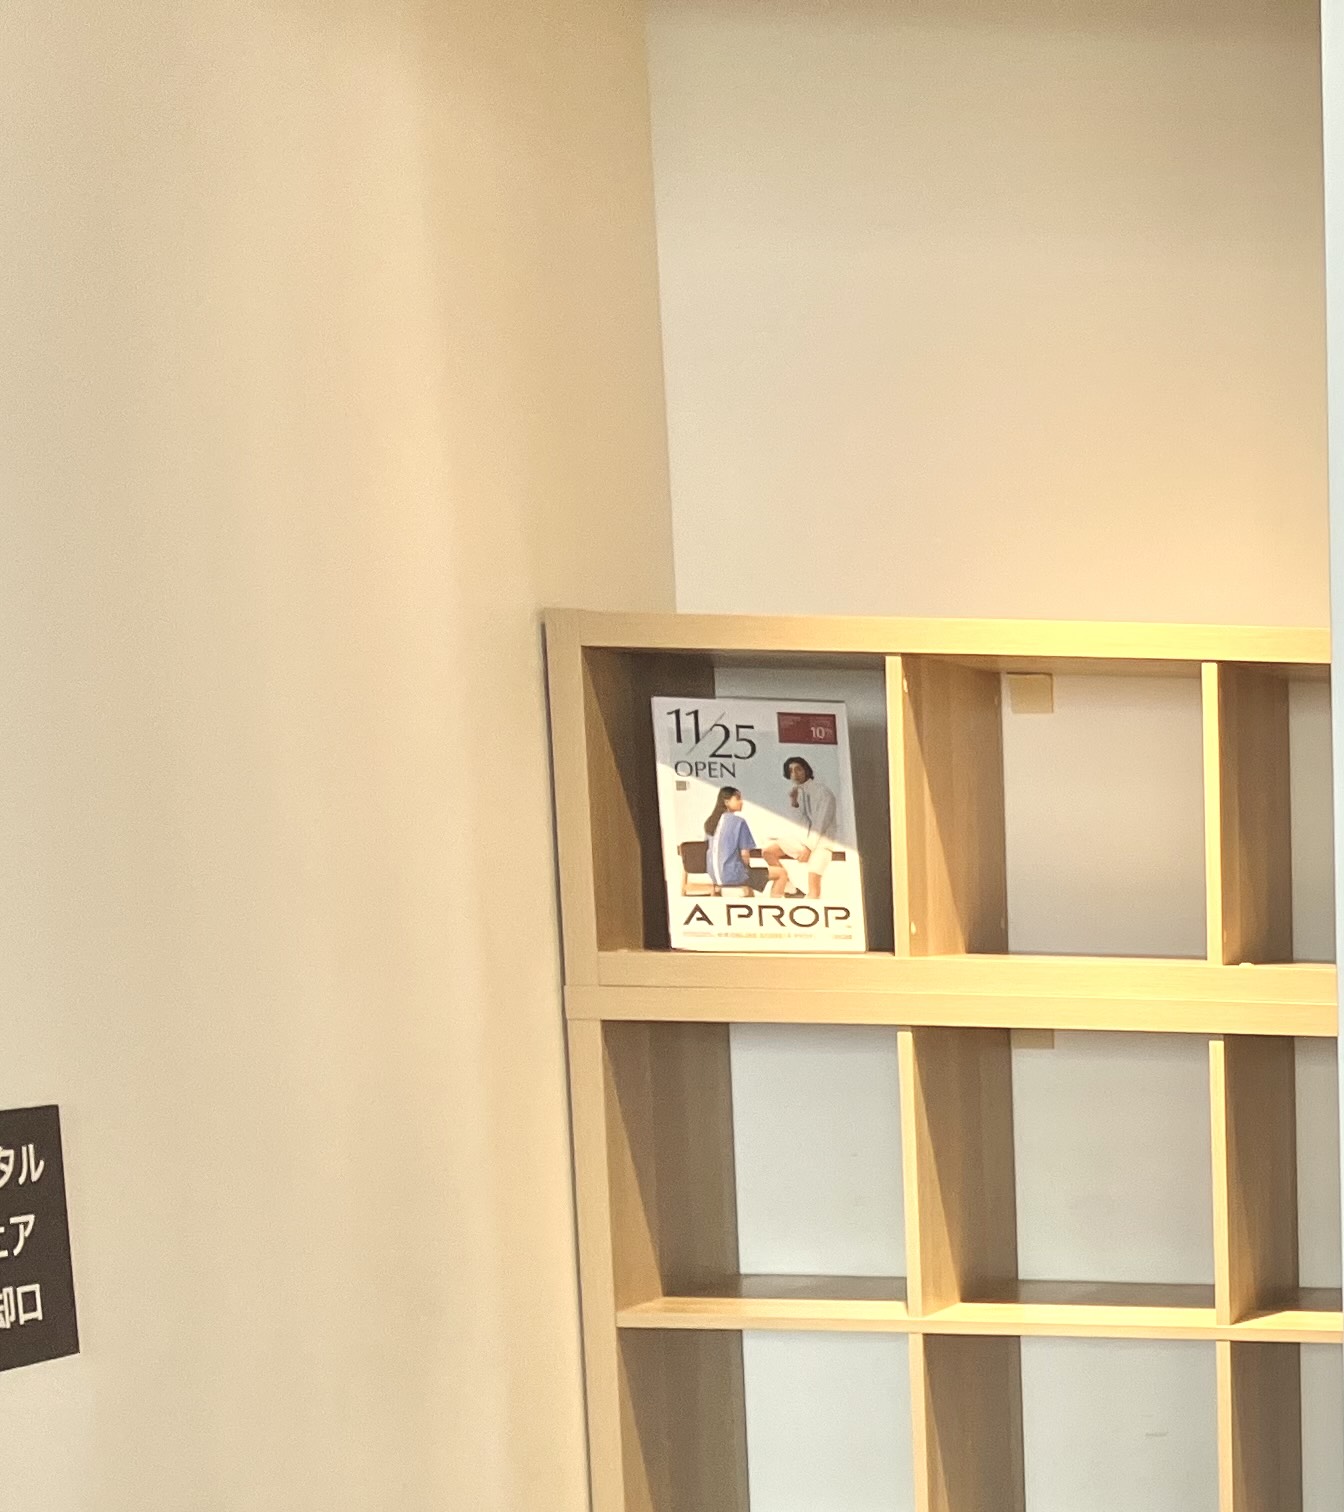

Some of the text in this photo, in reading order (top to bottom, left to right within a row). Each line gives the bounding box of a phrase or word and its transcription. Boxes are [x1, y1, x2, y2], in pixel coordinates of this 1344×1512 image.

[674, 761, 736, 778] OPEN
[683, 904, 851, 928] A PROP
